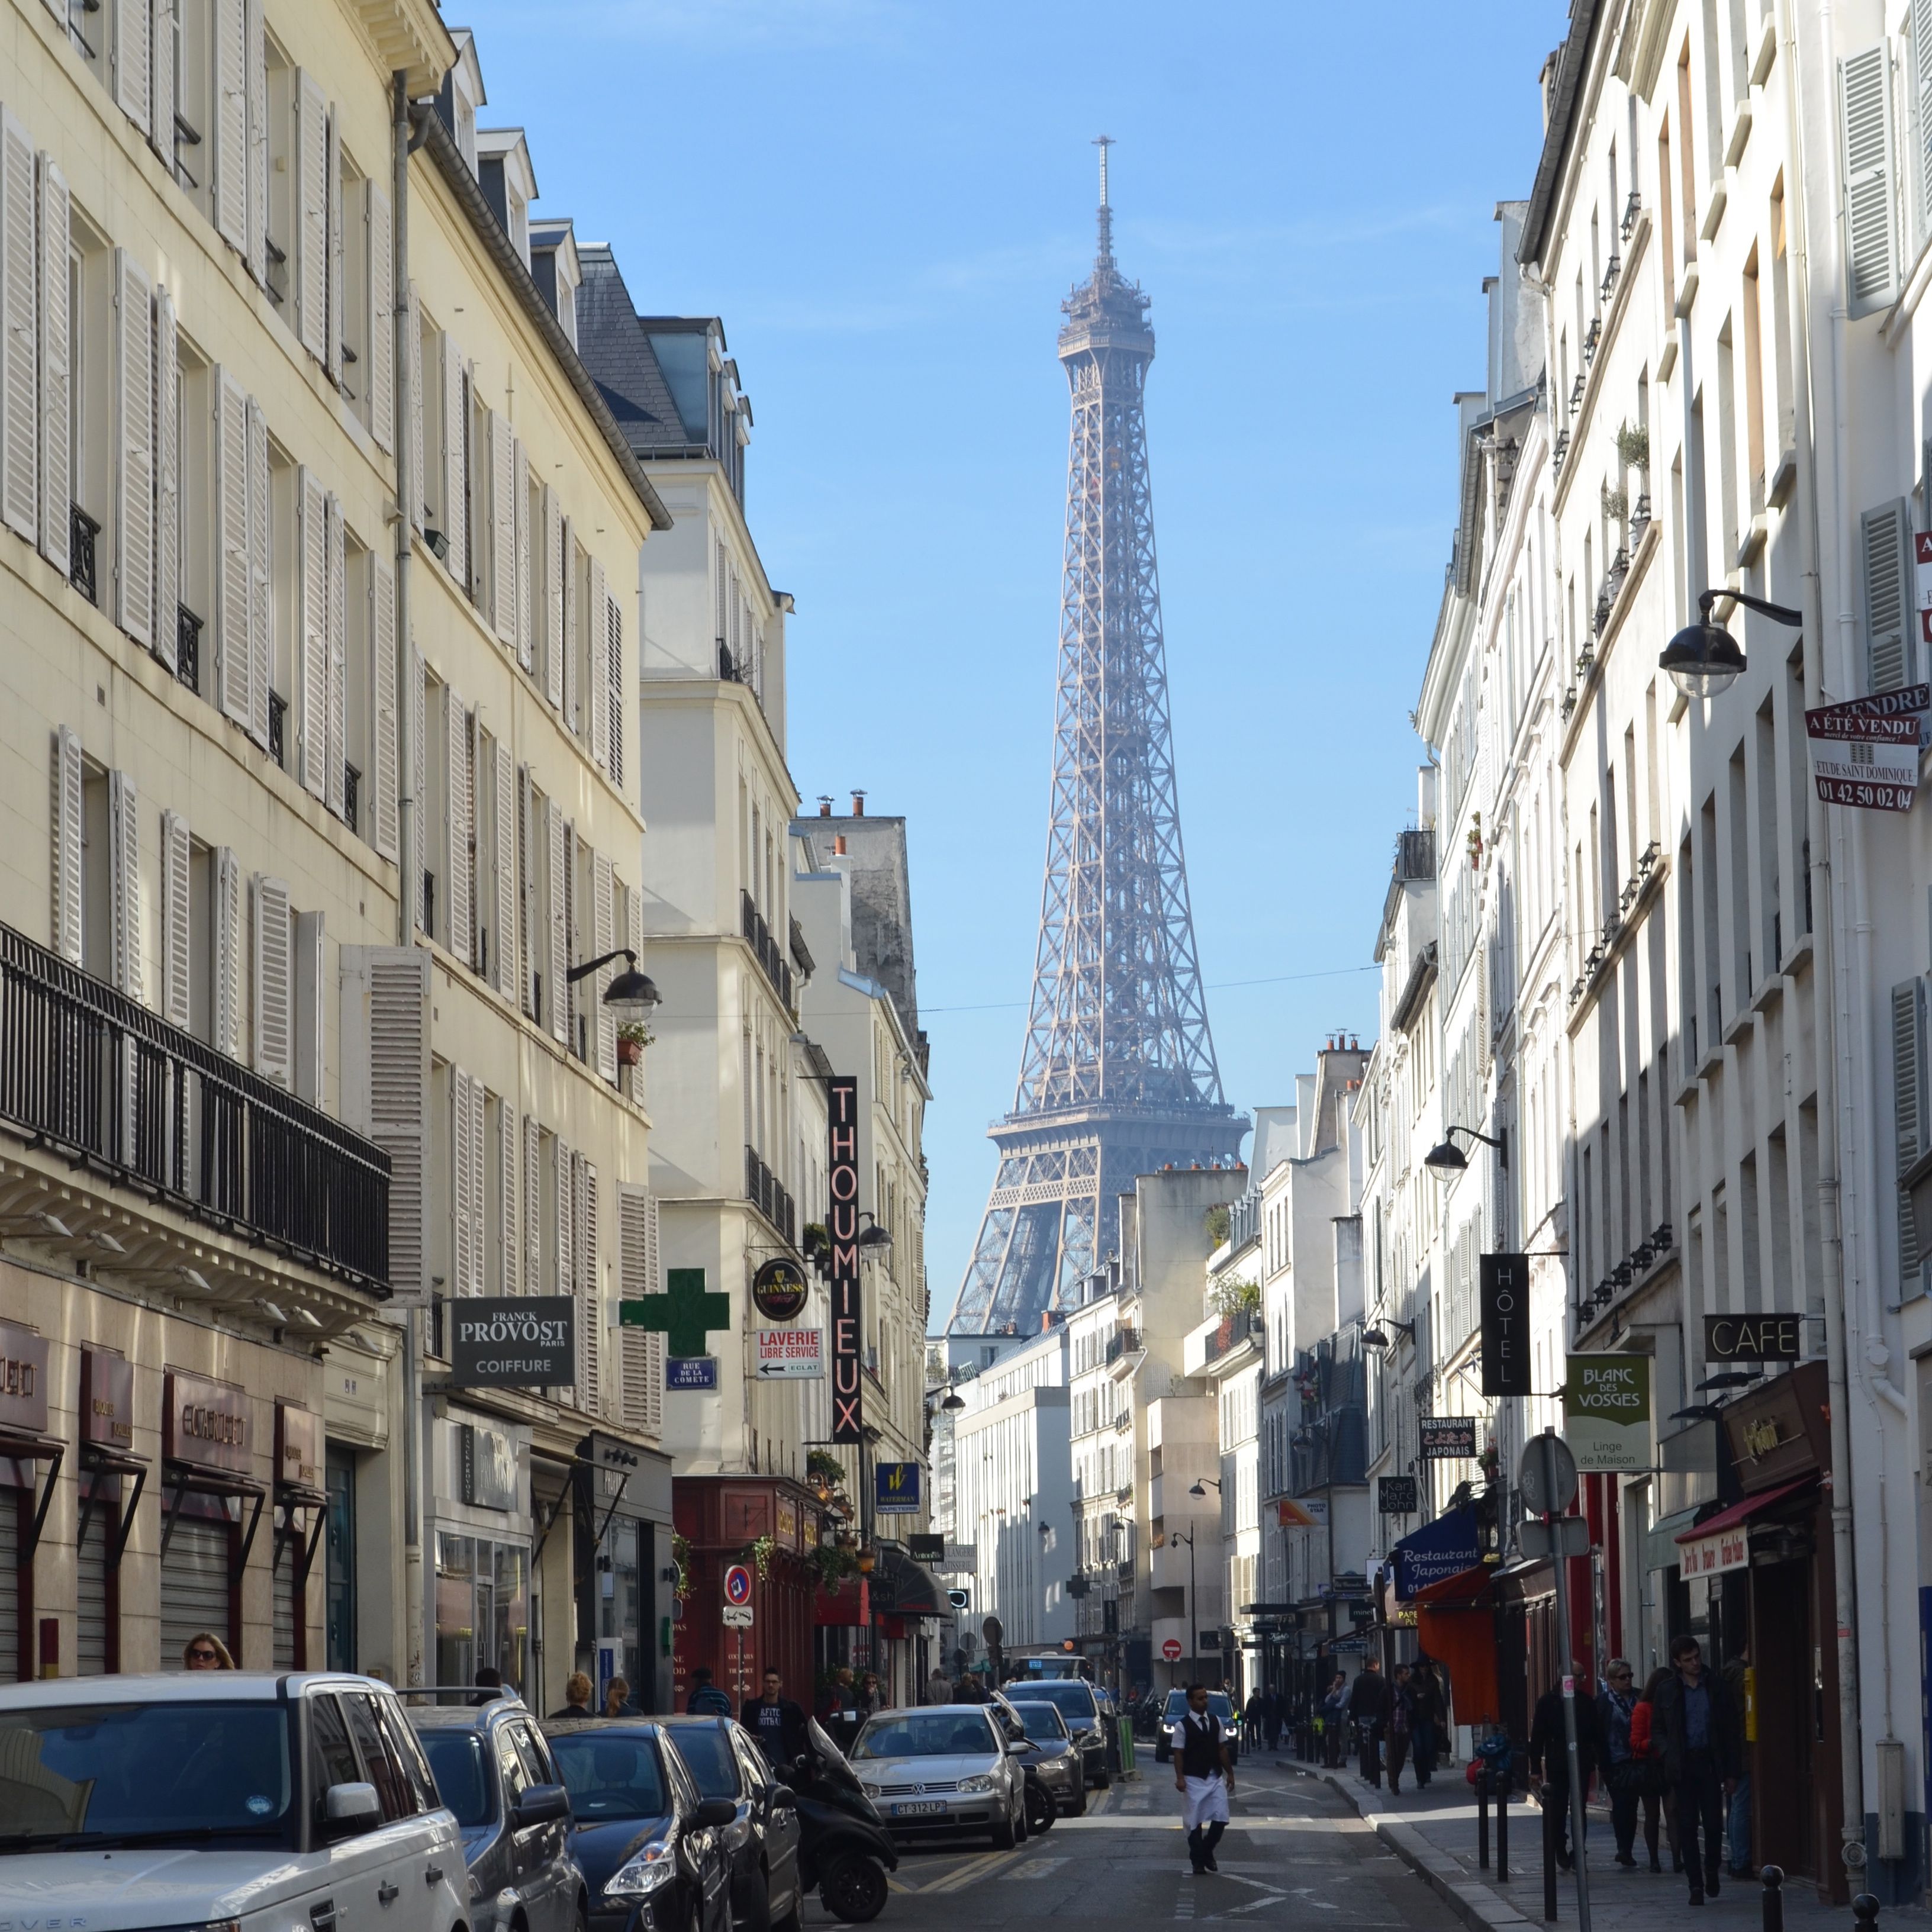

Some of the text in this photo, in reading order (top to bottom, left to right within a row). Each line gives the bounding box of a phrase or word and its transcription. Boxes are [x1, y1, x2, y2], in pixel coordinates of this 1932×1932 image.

[1811, 713, 1915, 735] A ÉTÉ VENDU
[1866, 734, 1896, 742] confiance
[1817, 761, 1912, 784] ETUDE SAINT DOMINIQUE
[1820, 780, 1912, 809] 01 42 50 02 04
[831, 1087, 859, 1432] THOUMIEUX
[758, 1283, 804, 1295] GUINNESS
[493, 1312, 537, 1321] FRANCK
[459, 1321, 567, 1341] PROVOST
[1497, 1268, 1513, 1382] HÔTEL
[760, 1331, 819, 1346] LAVERIE
[1712, 1321, 1795, 1354] CAFE
[760, 1347, 819, 1358] LIBRE SERVICE
[476, 1360, 551, 1373] COIFFURE
[1583, 1369, 1634, 1385] BLANC
[1600, 1383, 1617, 1392] DES
[1579, 1393, 1640, 1407] VOSGES
[1422, 1418, 1473, 1429] RESTAURANT
[1424, 1431, 1473, 1444] とよたか
[1427, 1446, 1469, 1456] JAPONAIS
[1593, 1442, 1622, 1453] Linge
[1580, 1456, 1635, 1464] de Maison
[1386, 1480, 1414, 1491] Karl
[1380, 1490, 1414, 1500] Marc
[1381, 1498, 1414, 1509] John
[1403, 1547, 1478, 1562] Restaurant
[941, 1560, 971, 1571] PATISSERIE
